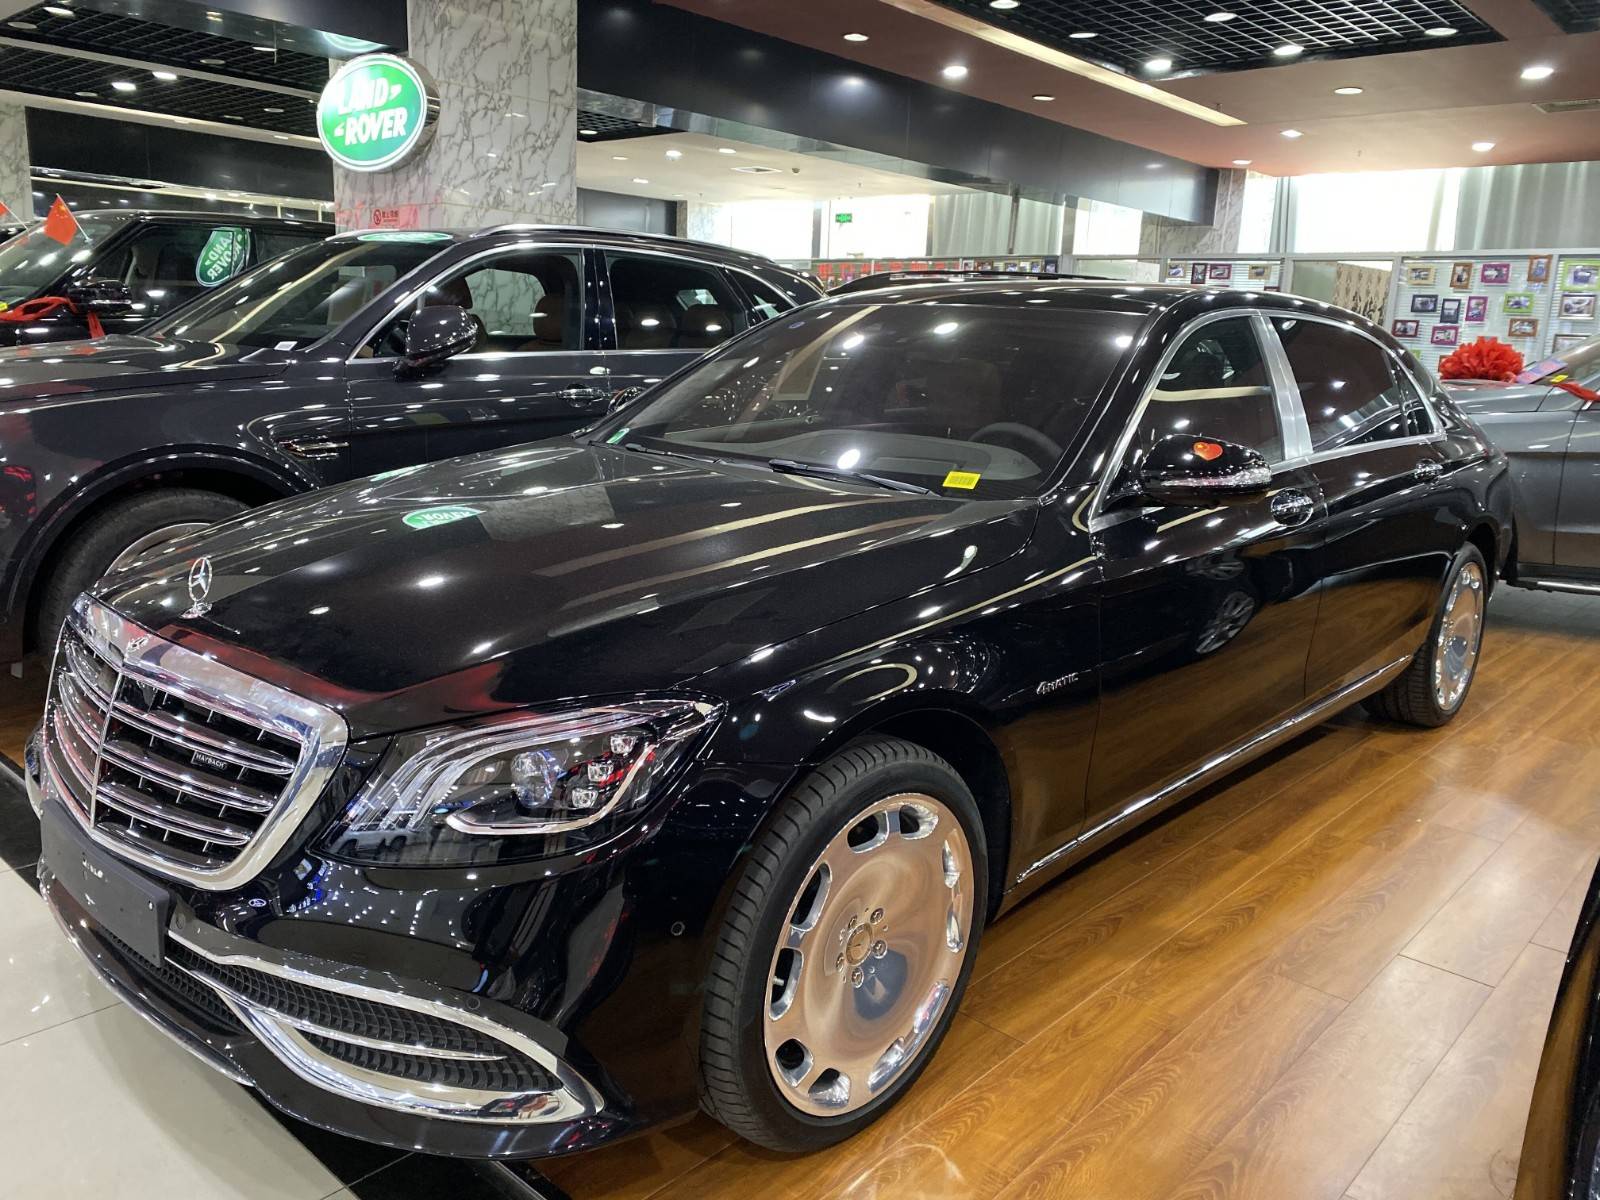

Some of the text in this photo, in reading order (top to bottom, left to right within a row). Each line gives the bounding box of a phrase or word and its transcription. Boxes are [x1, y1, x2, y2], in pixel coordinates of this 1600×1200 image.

[337, 78, 389, 115] LAND
[344, 107, 408, 146] ROVER
[195, 752, 225, 769] MAYBACH
